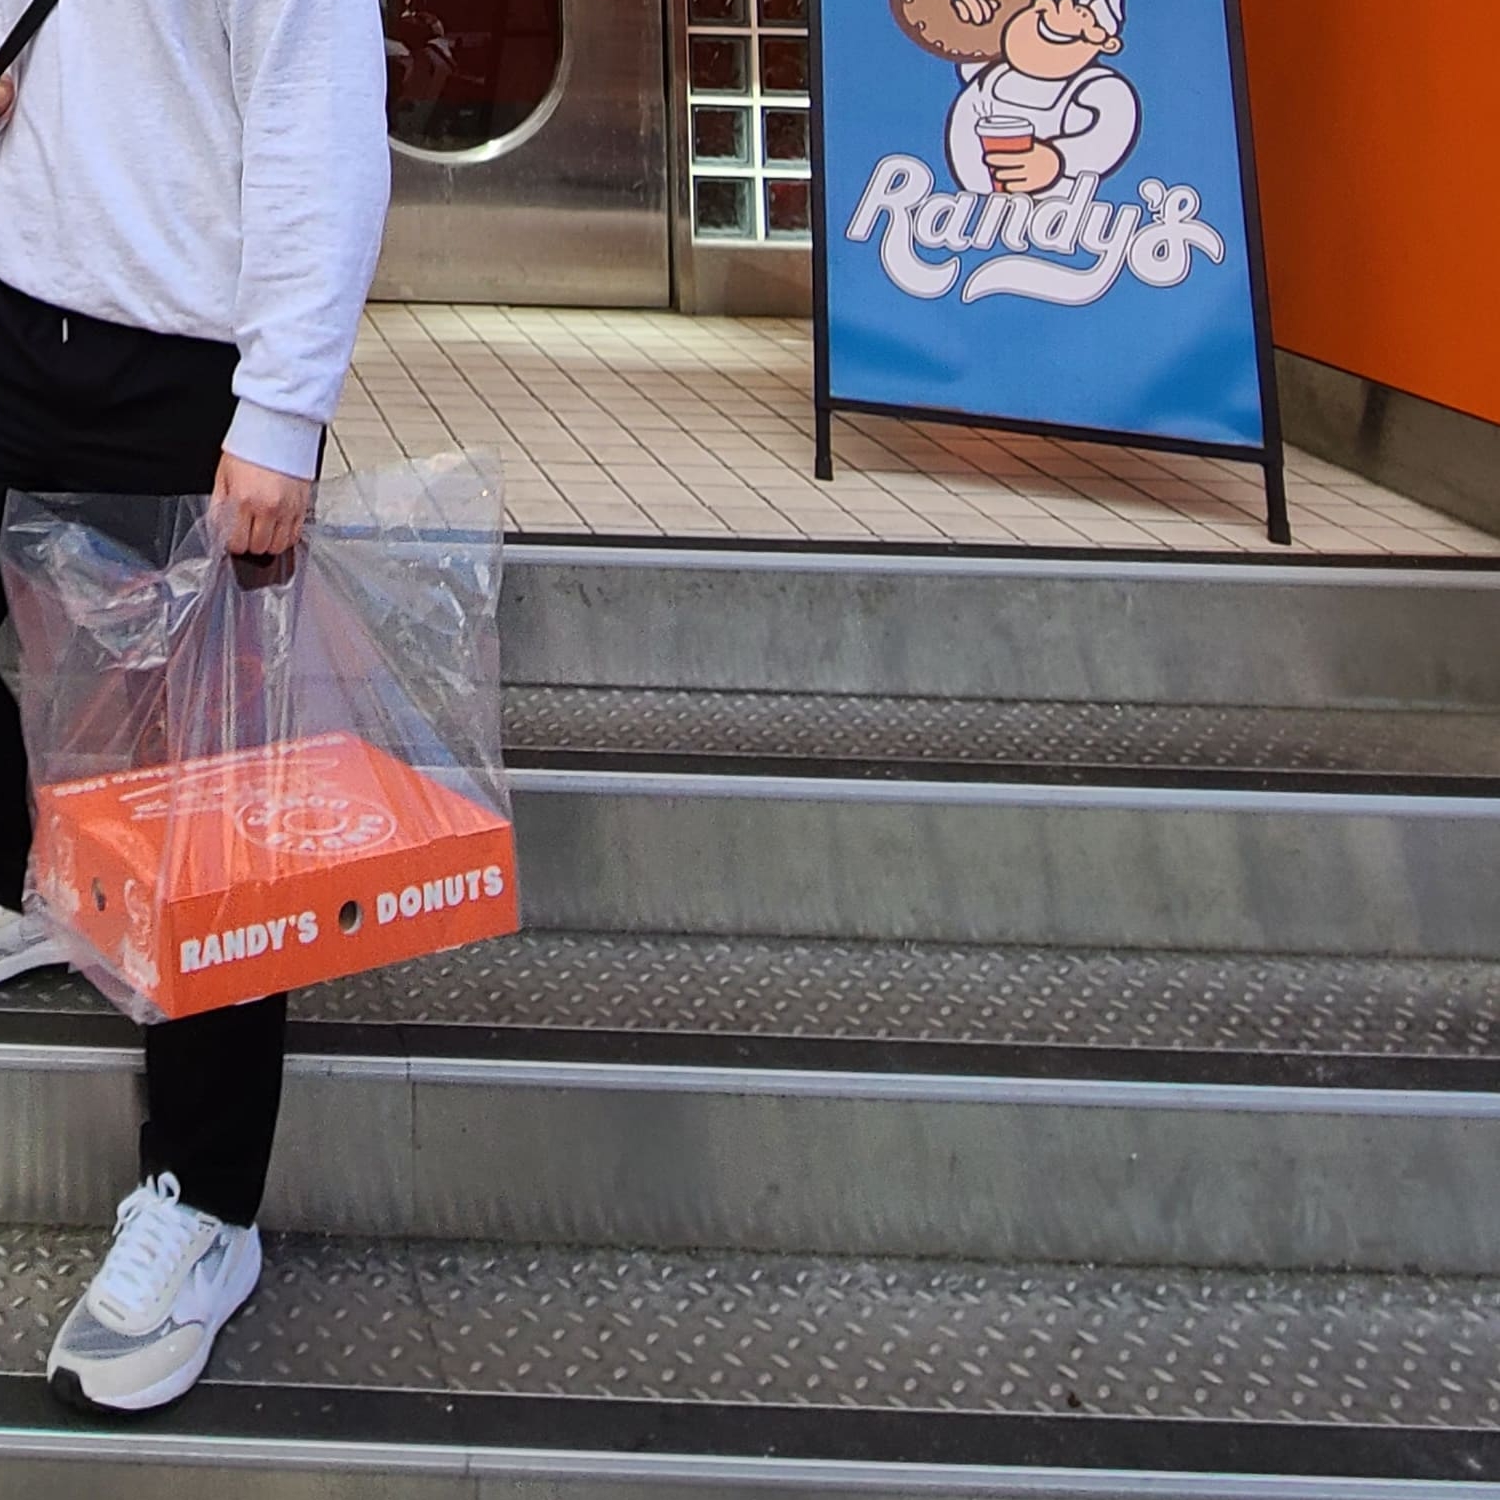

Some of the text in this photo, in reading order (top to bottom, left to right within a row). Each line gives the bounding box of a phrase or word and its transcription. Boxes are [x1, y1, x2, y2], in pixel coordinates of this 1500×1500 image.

[847, 153, 1226, 306] Randy's
[180, 865, 503, 973] RANDY'S DONUTS
